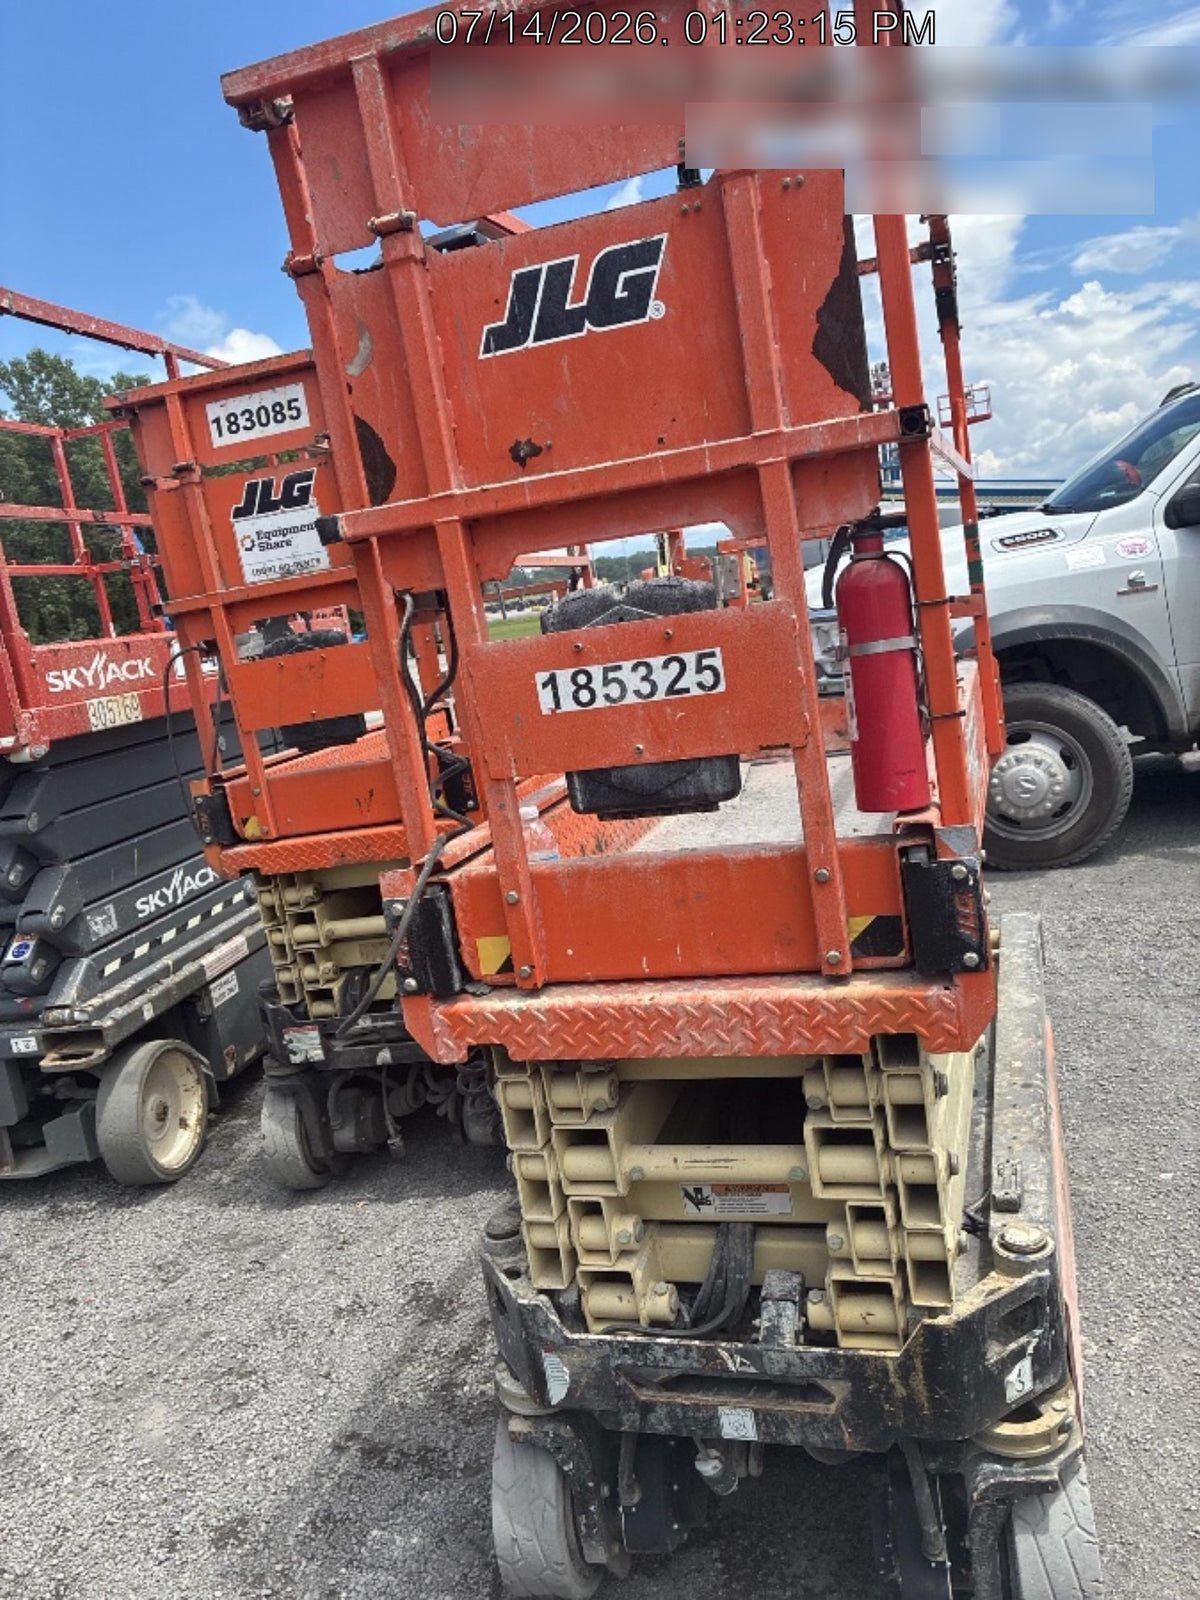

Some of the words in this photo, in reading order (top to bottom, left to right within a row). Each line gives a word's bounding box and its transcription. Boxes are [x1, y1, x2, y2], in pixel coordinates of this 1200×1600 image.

[478, 233, 669, 360] JLG
[211, 398, 303, 438] 183085
[230, 467, 317, 521] JLG
[257, 538, 293, 551] Share
[45, 651, 156, 692] SKYJACK
[541, 651, 721, 710] 185325
